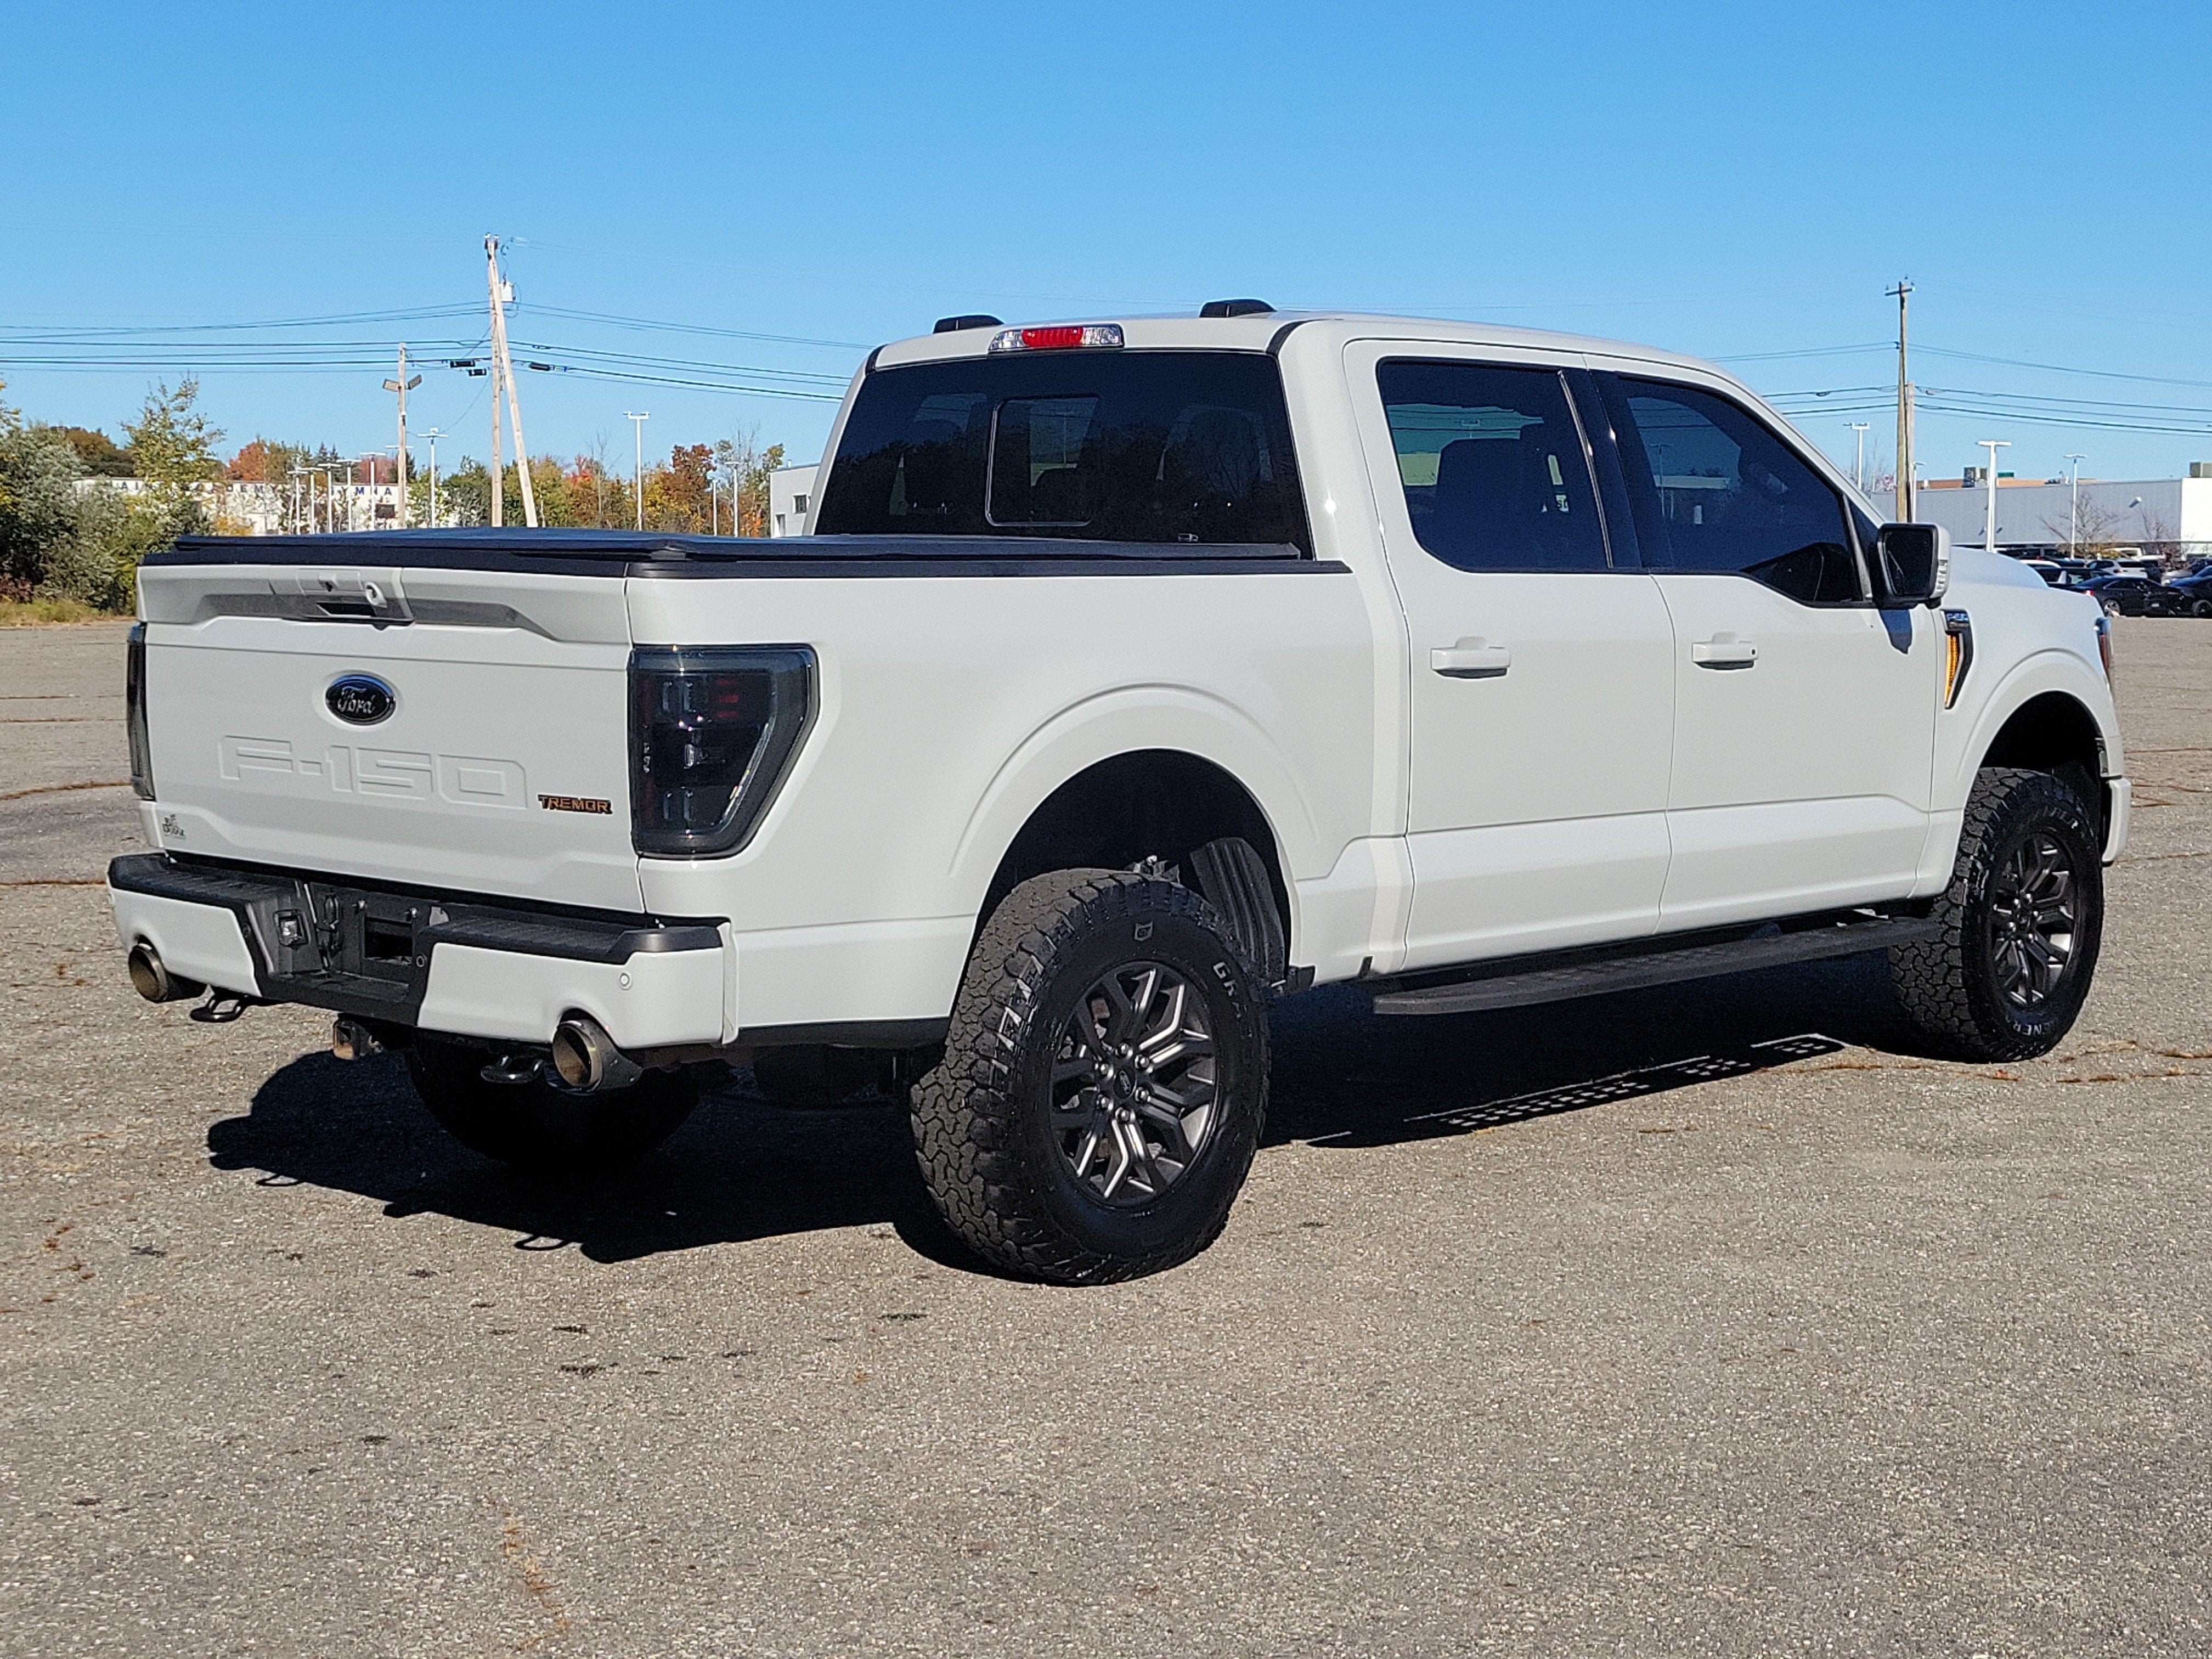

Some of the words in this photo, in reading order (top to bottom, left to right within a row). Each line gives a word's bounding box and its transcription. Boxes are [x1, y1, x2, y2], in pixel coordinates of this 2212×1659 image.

[337, 685, 376, 714] Ford
[218, 735, 528, 809] F-150
[538, 794, 613, 814] TREMOR
